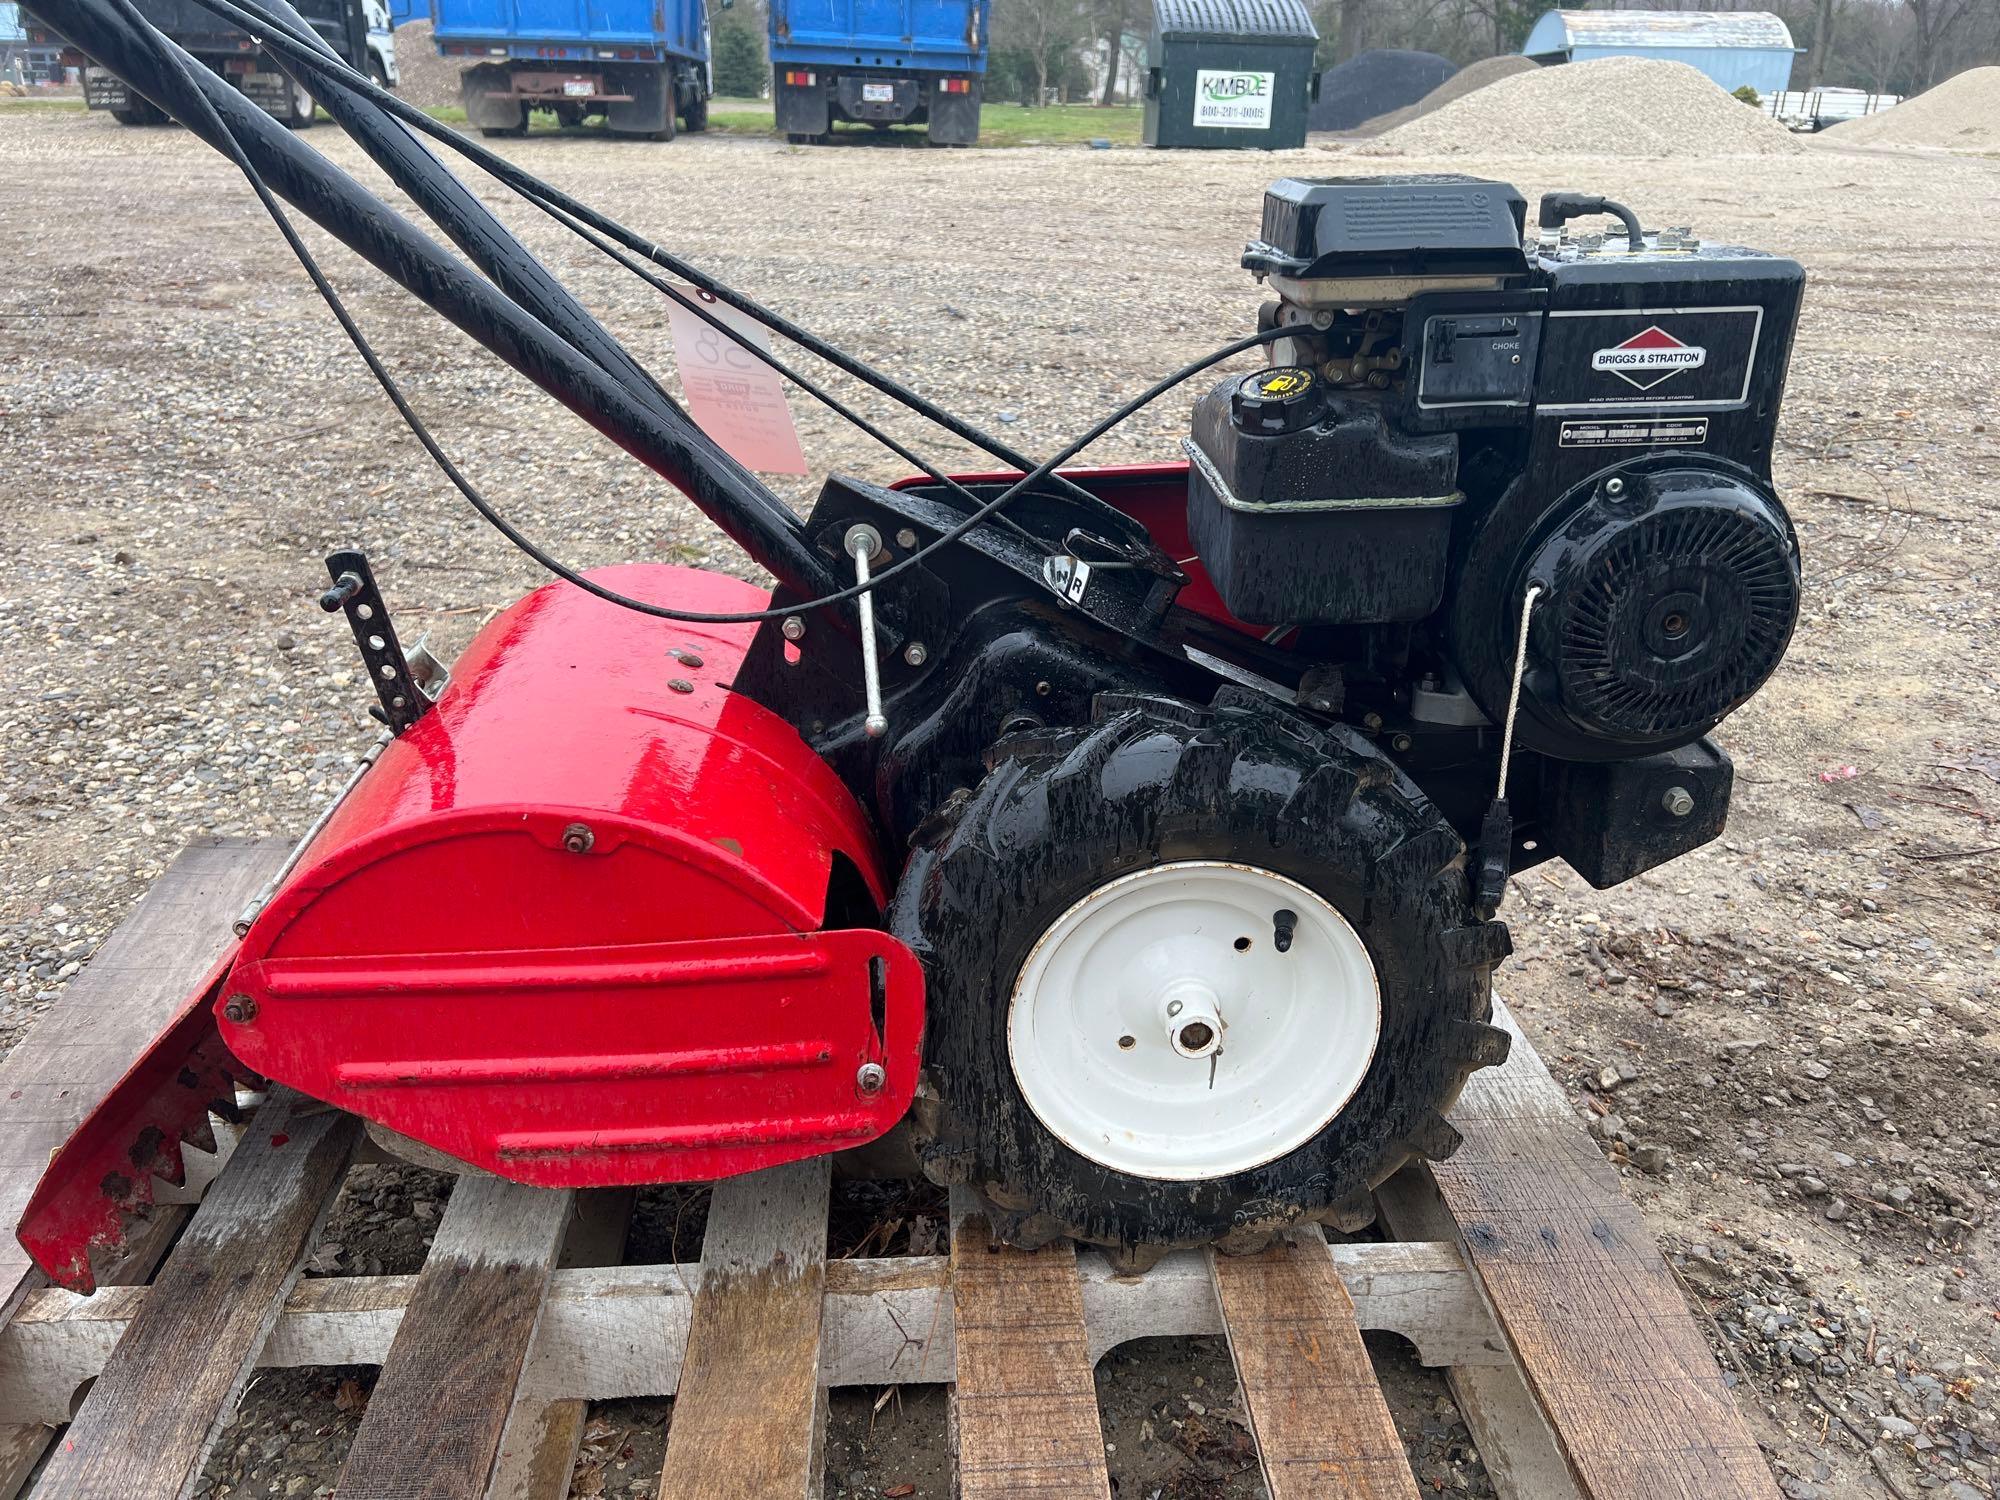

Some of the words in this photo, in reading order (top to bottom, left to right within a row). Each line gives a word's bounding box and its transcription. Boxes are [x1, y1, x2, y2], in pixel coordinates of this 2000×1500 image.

[1202, 77, 1267, 96] KIMBLE
[1492, 342, 1520, 350] CHOKE
[1598, 354, 1637, 364] BRIGGS
[1638, 354, 1645, 363] &
[1647, 353, 1700, 363] STRATTON
[1056, 570, 1069, 584] N
[1072, 577, 1083, 594] R
